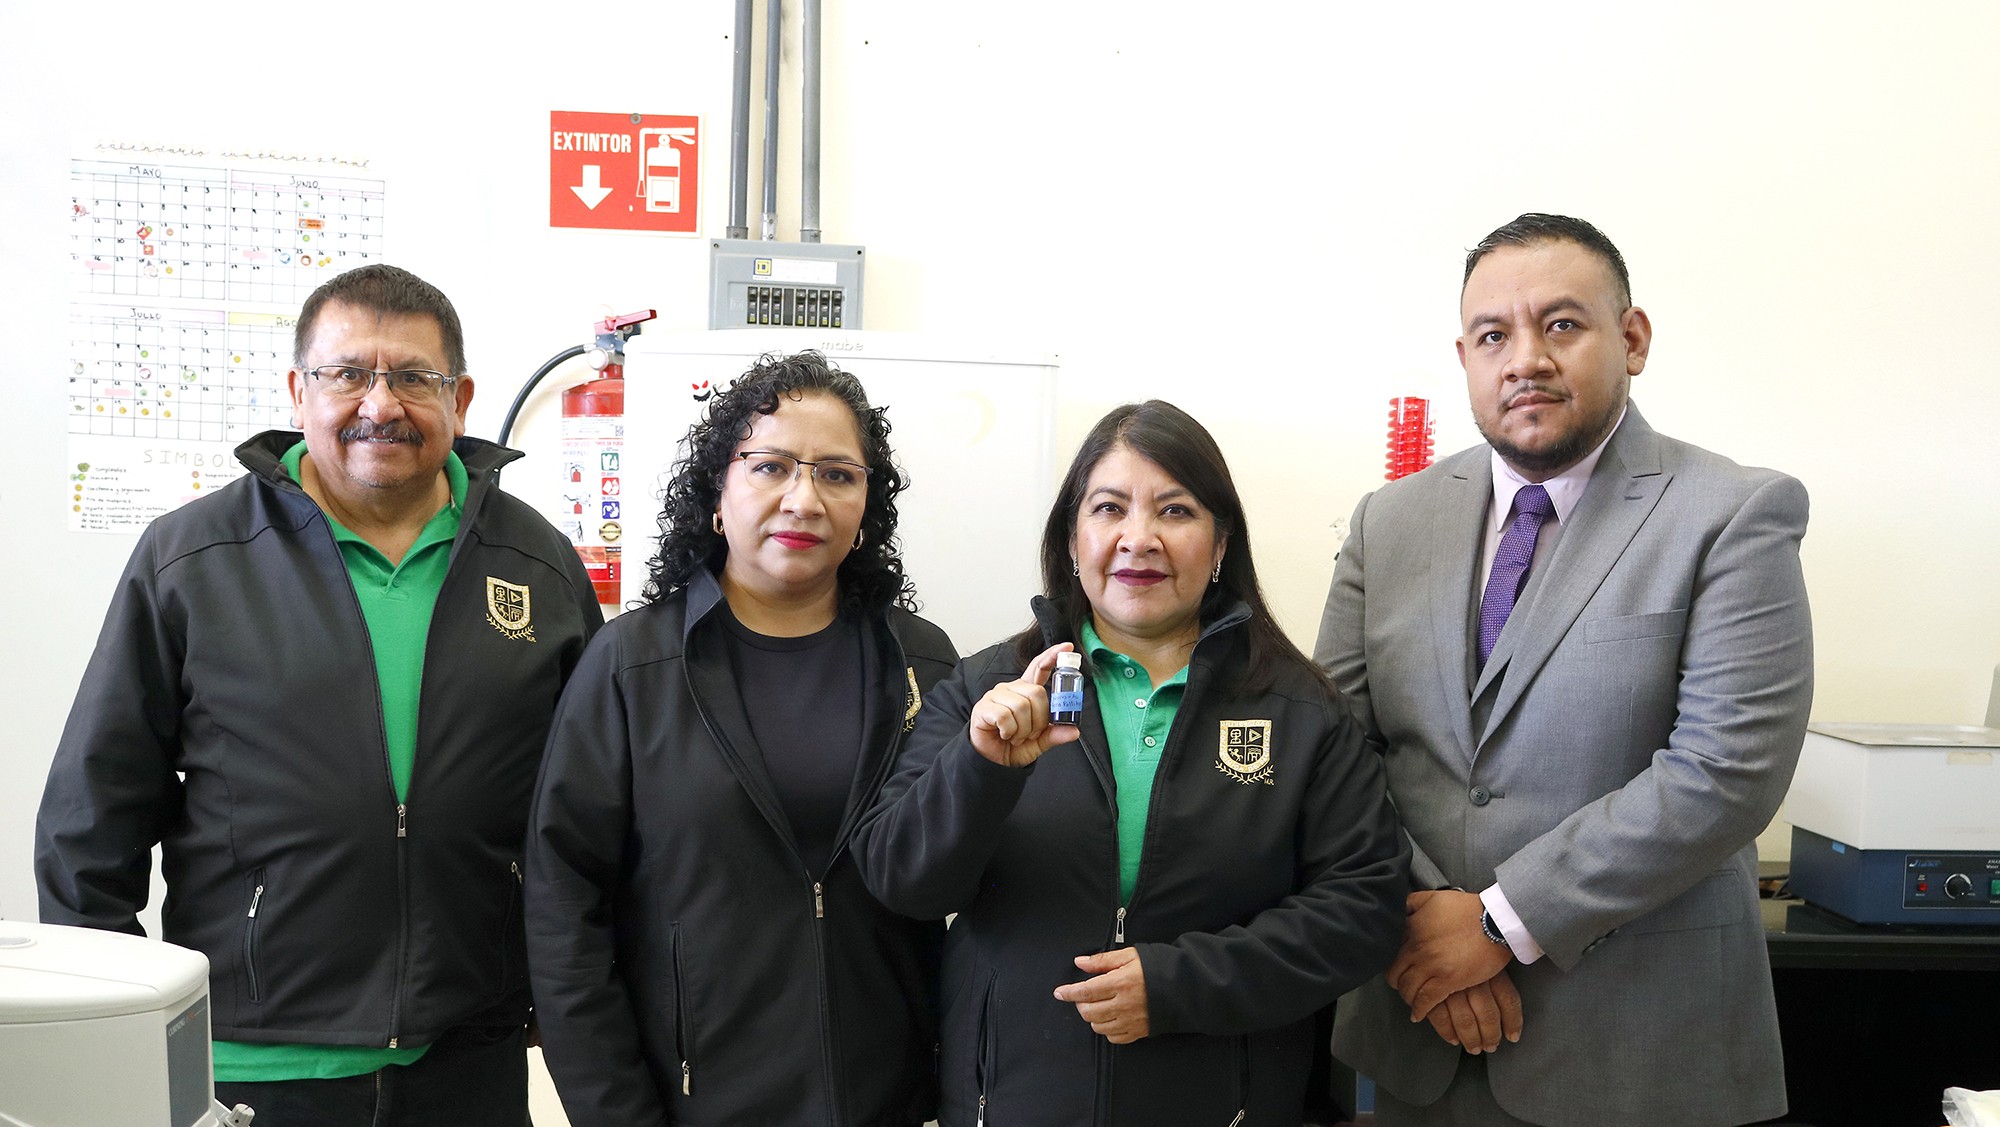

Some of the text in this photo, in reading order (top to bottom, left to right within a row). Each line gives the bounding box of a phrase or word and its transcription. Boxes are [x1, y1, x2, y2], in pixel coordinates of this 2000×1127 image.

[553, 131, 632, 154] EXTINTOR
[129, 165, 162, 179] MAYO
[289, 175, 319, 189] JUNIO
[131, 307, 162, 320] JULIO
[820, 337, 864, 352] mabe
